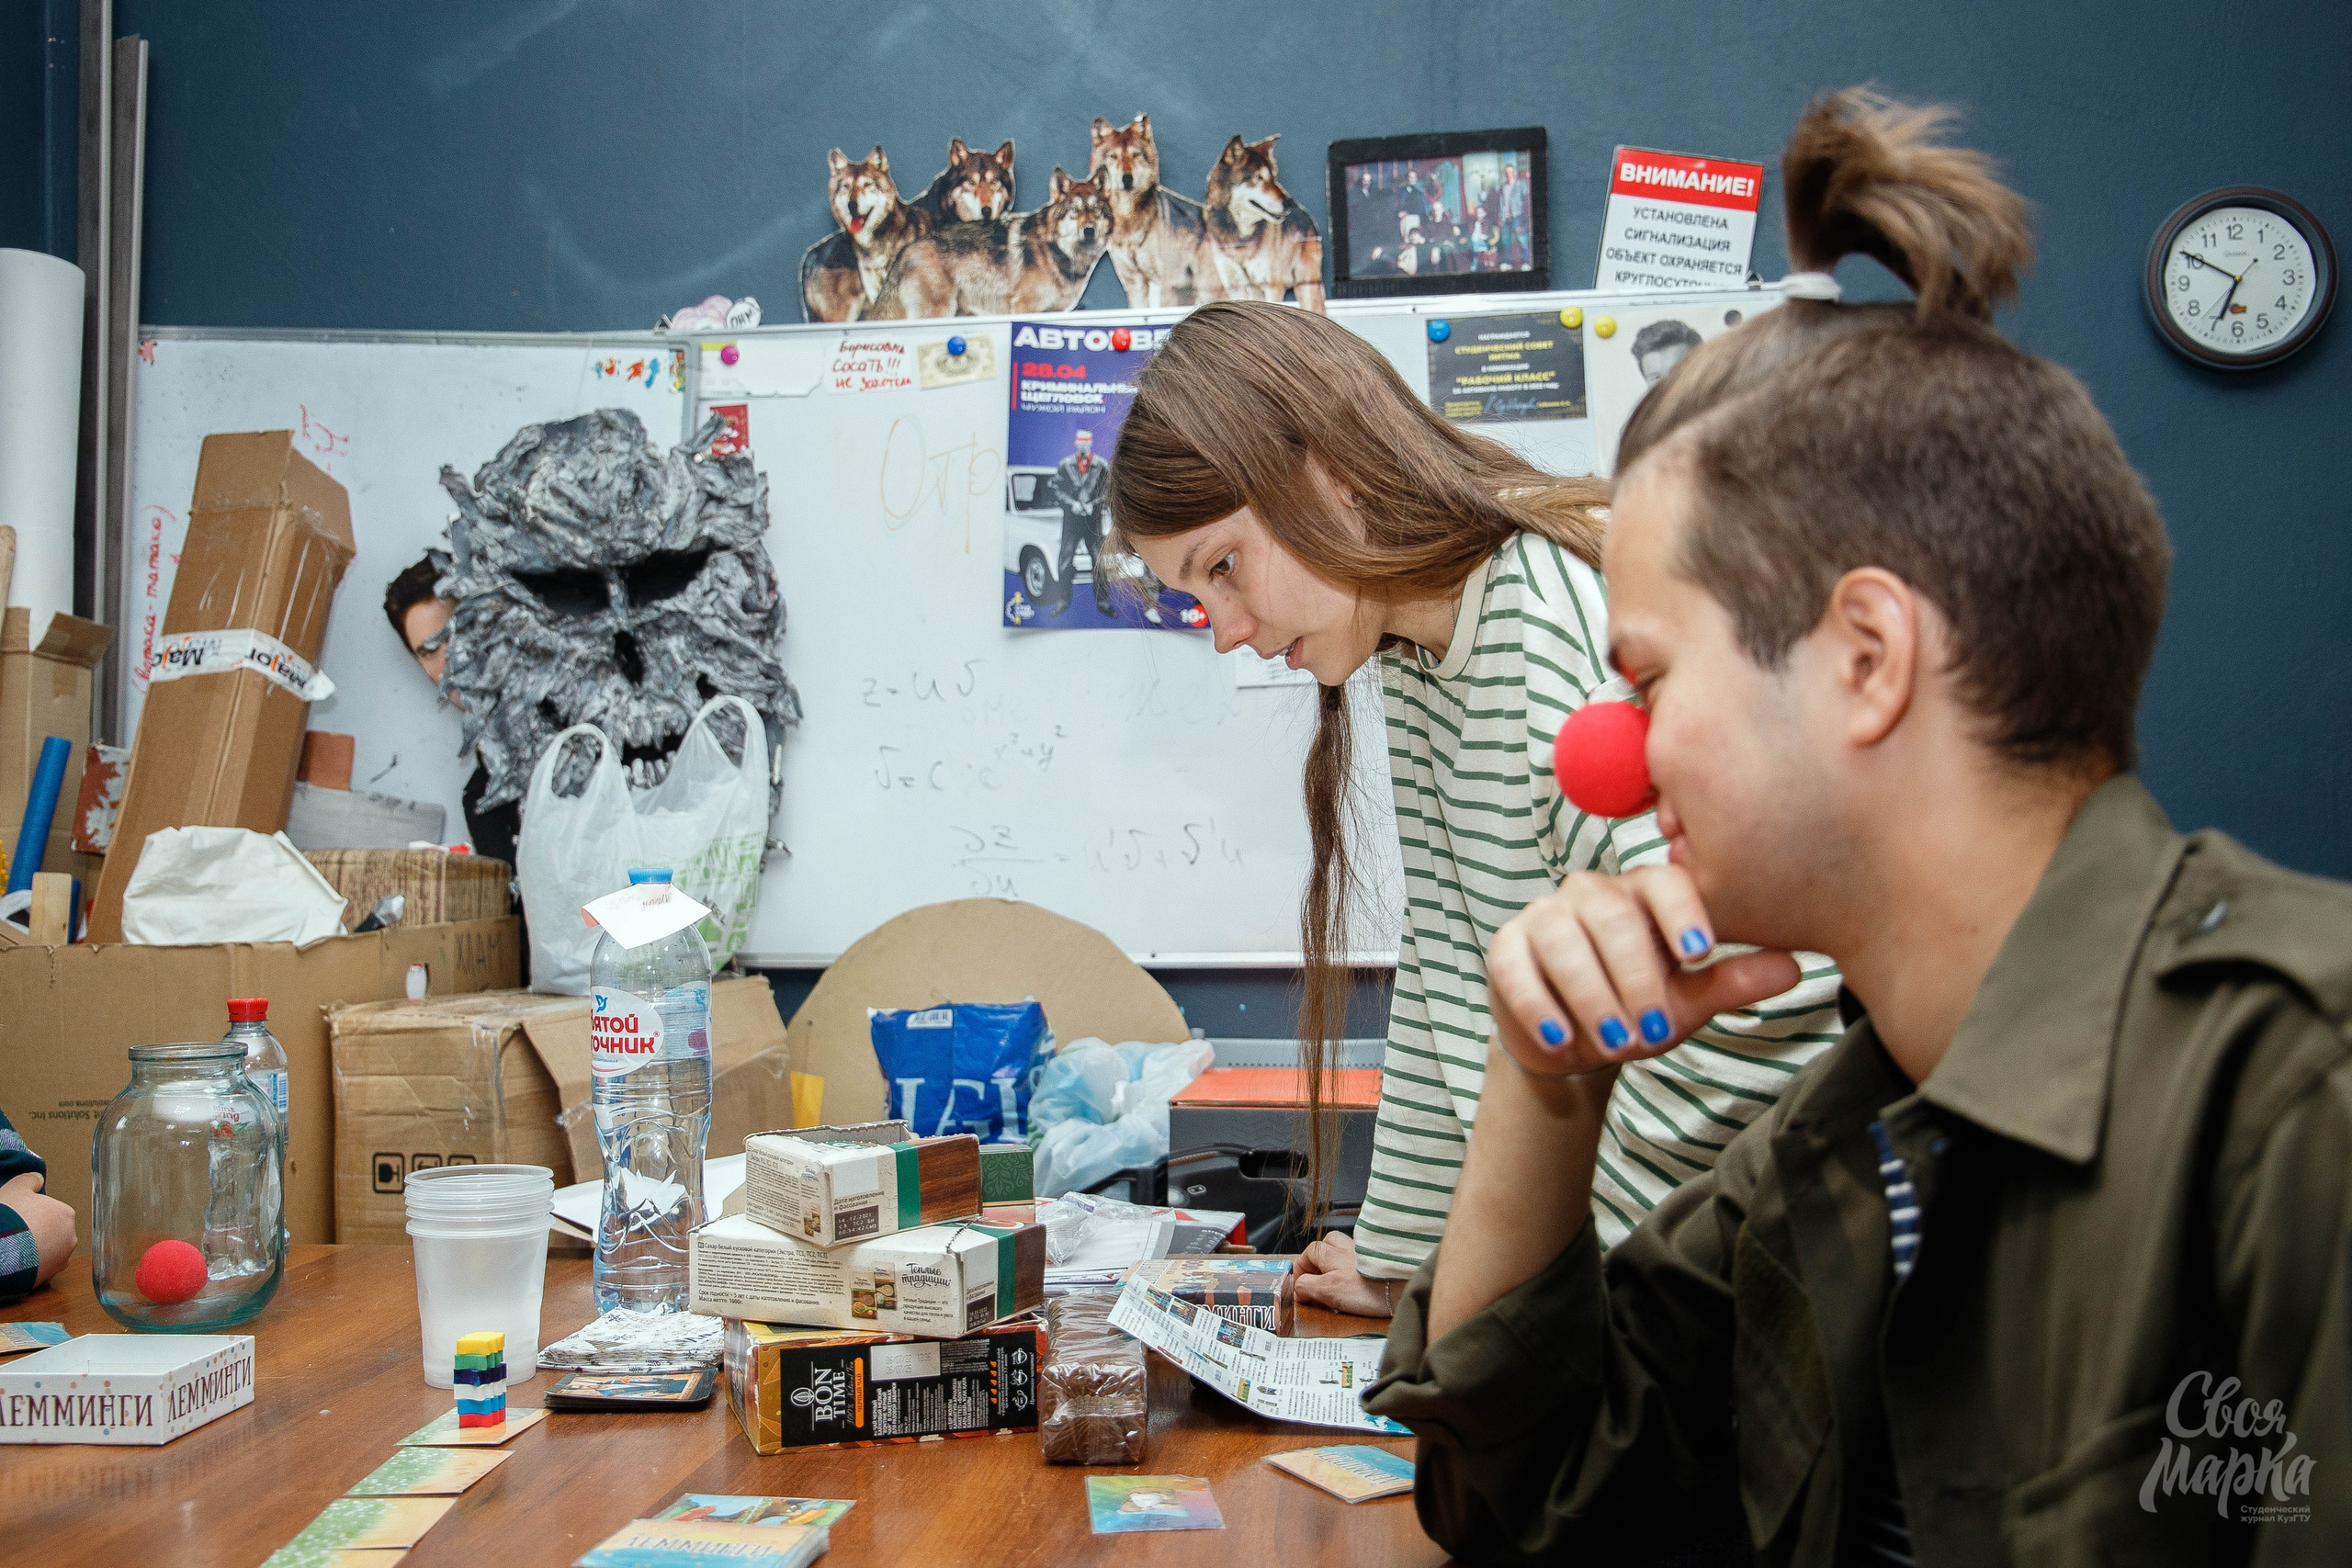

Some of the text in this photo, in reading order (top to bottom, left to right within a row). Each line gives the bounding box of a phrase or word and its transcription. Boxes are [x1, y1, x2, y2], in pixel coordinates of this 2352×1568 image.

[1620, 162, 1755, 197] ВНИМАНИЕ!
[1633, 206, 1729, 230] УСТАНОВЛЕНА
[1624, 227, 1731, 253] СИГНАЛИЗАЦИЯ
[2201, 232, 2217, 248] 11
[2226, 223, 2244, 241] 12
[2257, 229, 2264, 243] 1
[2273, 243, 2285, 261] 2
[1606, 247, 1743, 276] ОБЪЕКТ ОХРАНЯЕТСЯ
[2184, 254, 2204, 270] 10
[2177, 275, 2190, 292] 9
[2283, 268, 2296, 286] 3
[2188, 299, 2200, 317] 8
[2275, 295, 2287, 310] 4
[2209, 315, 2223, 332] 7
[2232, 321, 2245, 338] 6
[2256, 313, 2269, 330] 5
[1454, 340, 1555, 355] СТУДЕНЧЕСКИЙ СОВЕТ
[1022, 362, 1087, 379] 28.04
[1021, 380, 1138, 394] КРИМИНАЛЬН
[243, 648, 308, 690] Major
[28, 1111, 46, 1121] Inc.
[49, 1110, 91, 1121] Solutions
[848, 1190, 884, 1202] изготовления
[839, 1201, 867, 1211] фасования
[705, 1243, 718, 1251] Сахар
[753, 1247, 777, 1256] категории
[777, 1248, 795, 1257] (Экстра,
[807, 1250, 817, 1258] ТС2,
[906, 1262, 942, 1275] Теплые
[167, 1356, 252, 1423] ЛЕММИНГИ
[815, 1368, 833, 1422] BON
[833, 1371, 846, 1418] TIME
[620, 1534, 775, 1558] ЛЕММИНГИ
